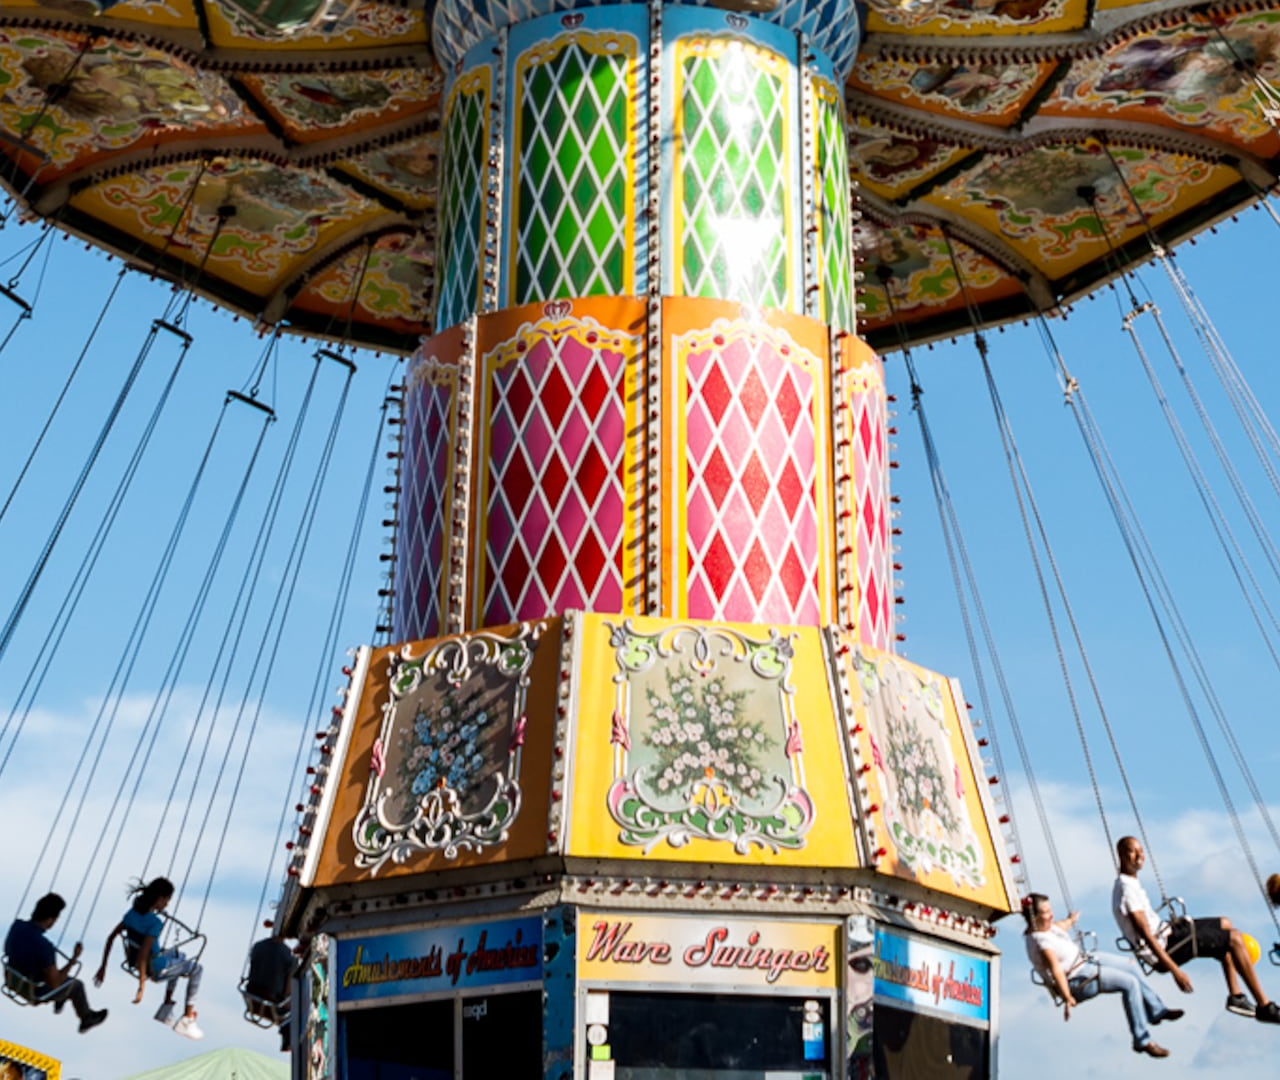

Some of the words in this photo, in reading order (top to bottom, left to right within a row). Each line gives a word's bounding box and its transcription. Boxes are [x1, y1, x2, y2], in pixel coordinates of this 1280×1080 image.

[342, 944, 443, 988] Amusements
[445, 938, 467, 986] of
[466, 928, 538, 975] America
[586, 921, 672, 964] Wave
[683, 927, 830, 983] Swinger
[931, 961, 944, 1006] of
[943, 959, 982, 1007] America
